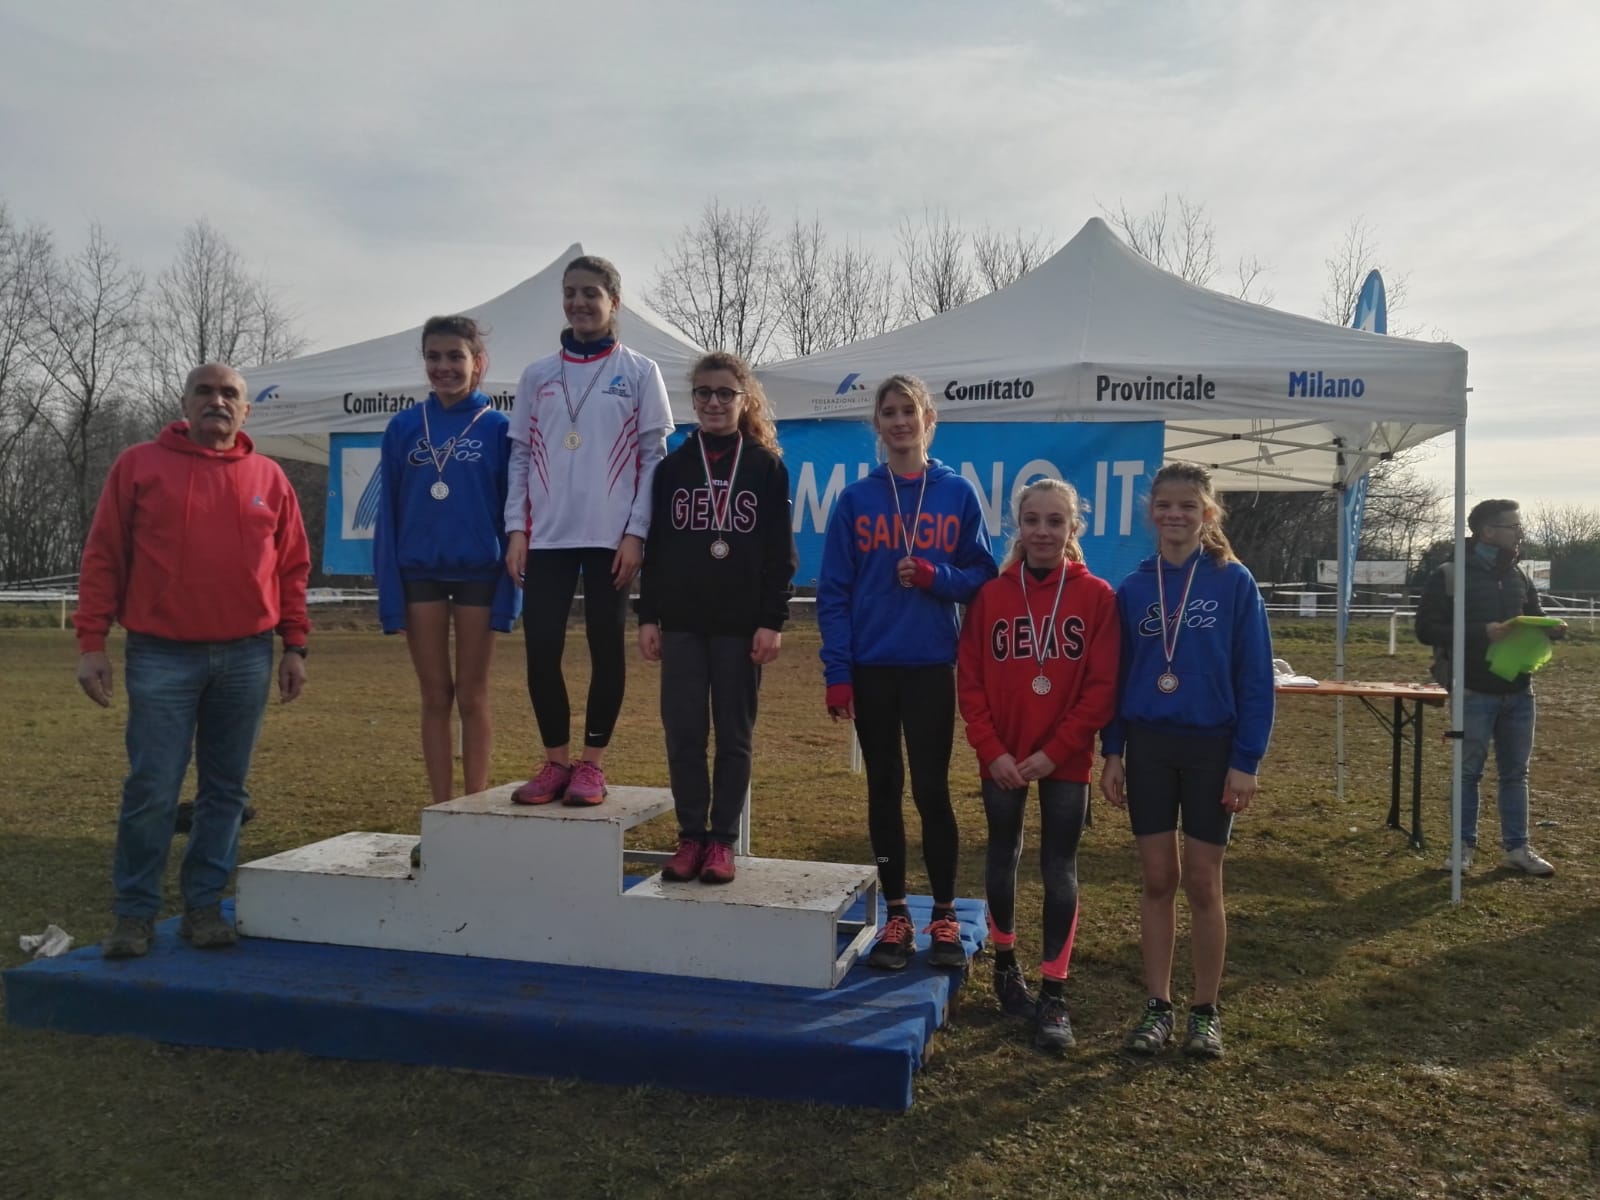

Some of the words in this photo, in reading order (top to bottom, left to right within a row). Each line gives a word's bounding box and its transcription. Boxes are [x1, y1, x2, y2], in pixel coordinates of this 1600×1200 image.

[944, 377, 1034, 401] Comitato
[1096, 374, 1216, 401] Provinciale
[1288, 371, 1365, 398] Milano
[855, 512, 960, 553] SANGIO
[1188, 599, 1219, 612] 20
[1187, 615, 1217, 629] 02
